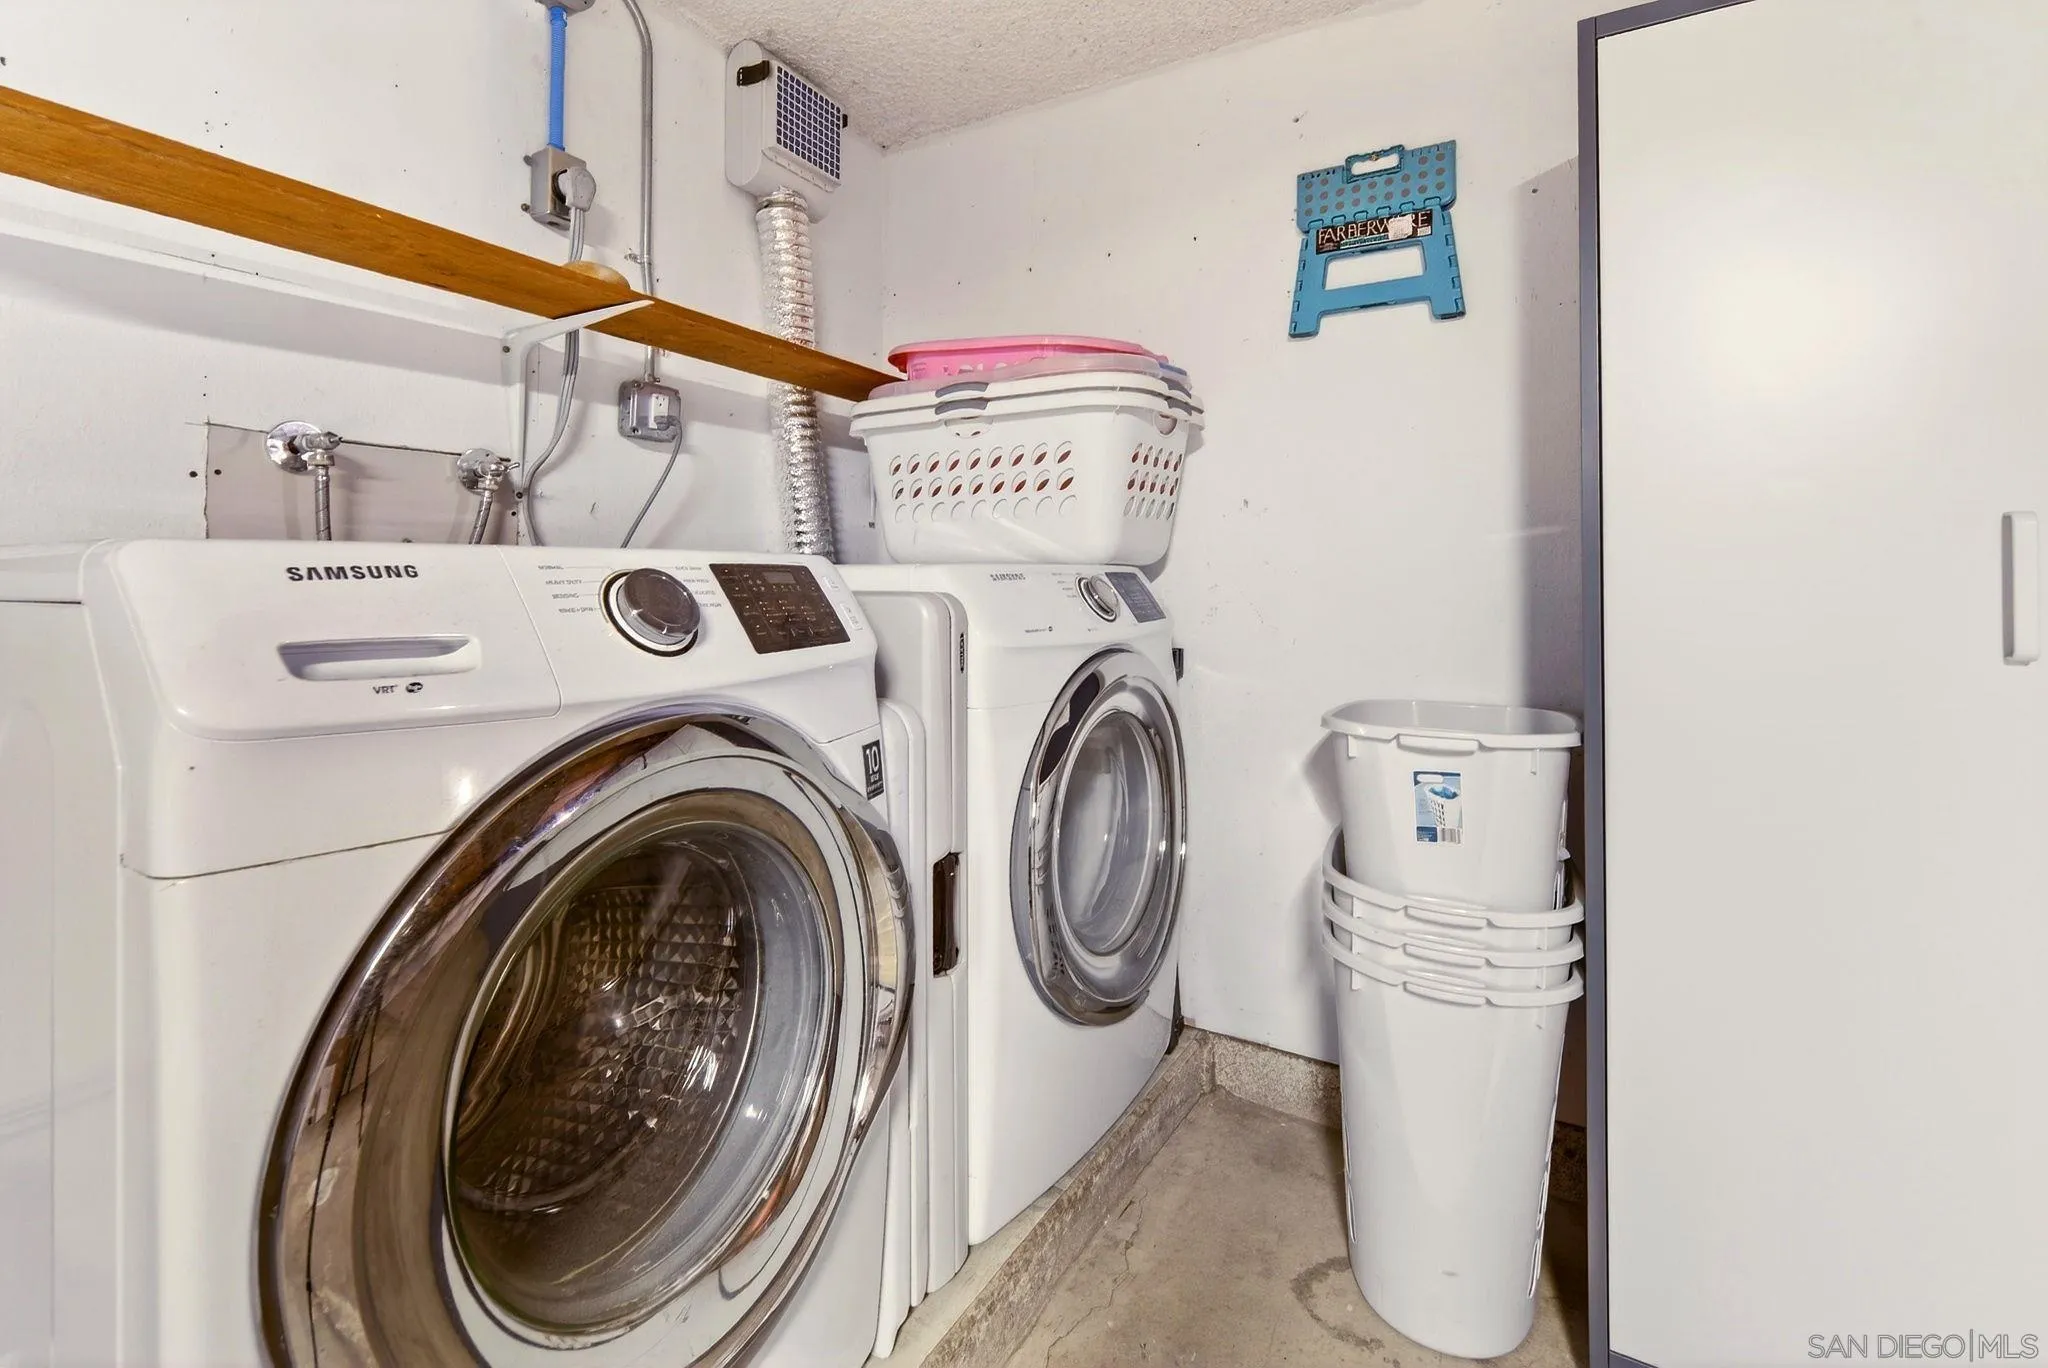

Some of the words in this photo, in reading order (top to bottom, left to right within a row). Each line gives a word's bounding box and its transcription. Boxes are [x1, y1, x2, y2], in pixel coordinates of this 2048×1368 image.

[1318, 210, 1431, 245] FARBERWRE
[286, 564, 419, 582] SAMSUNG
[866, 746, 880, 774] 10
